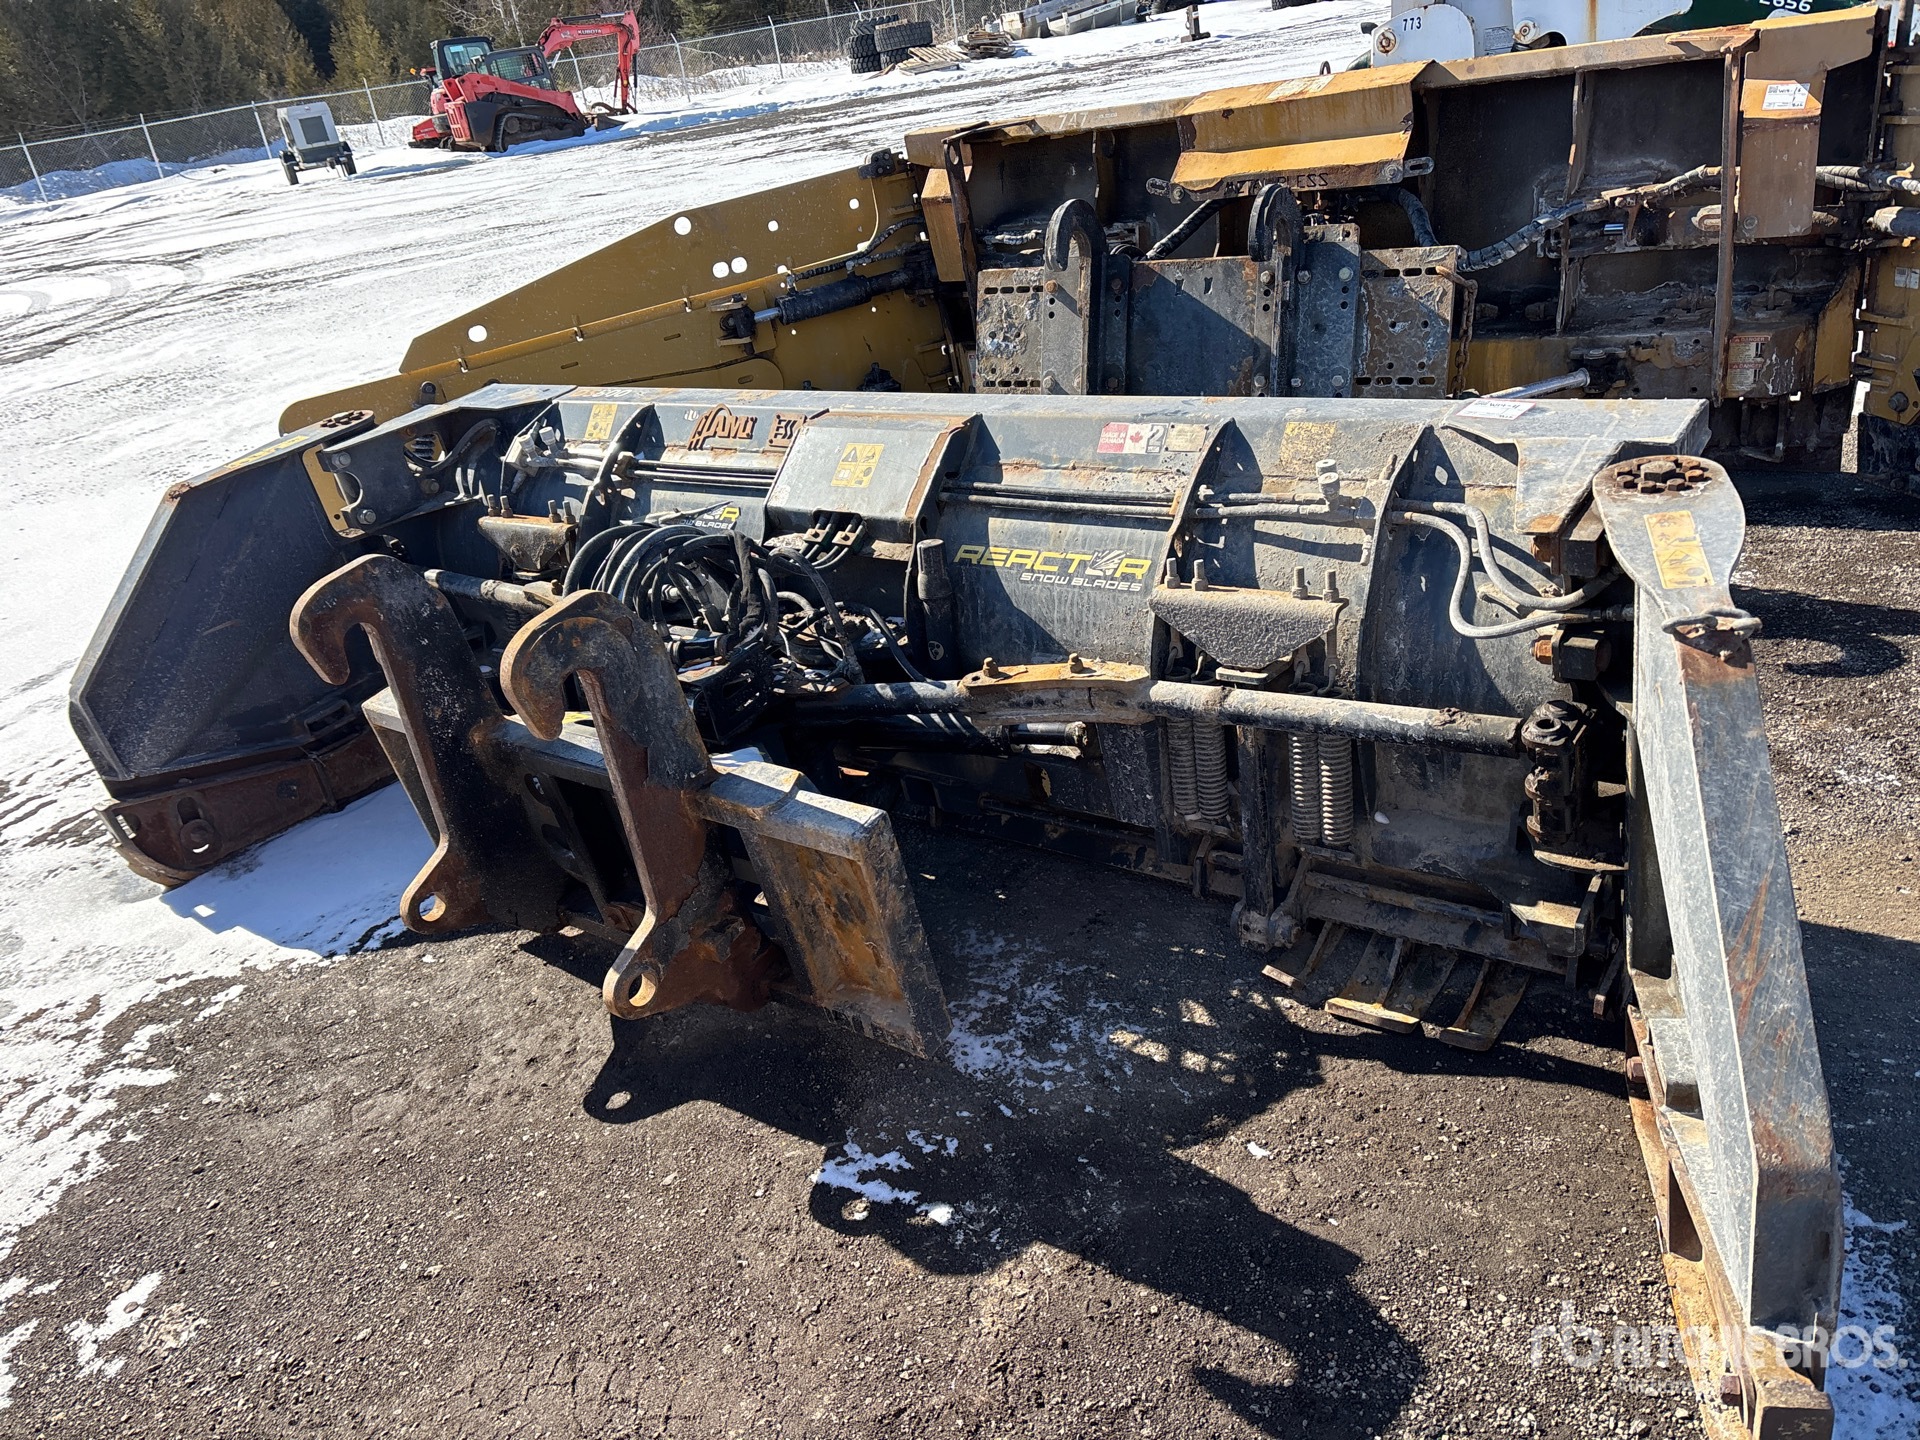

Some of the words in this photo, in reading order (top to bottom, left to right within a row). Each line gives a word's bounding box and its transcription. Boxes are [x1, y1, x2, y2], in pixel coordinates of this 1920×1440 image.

[1402, 16, 1422, 32] 773
[1020, 572, 1070, 585] SNOW
[1071, 577, 1143, 592] BLADES
